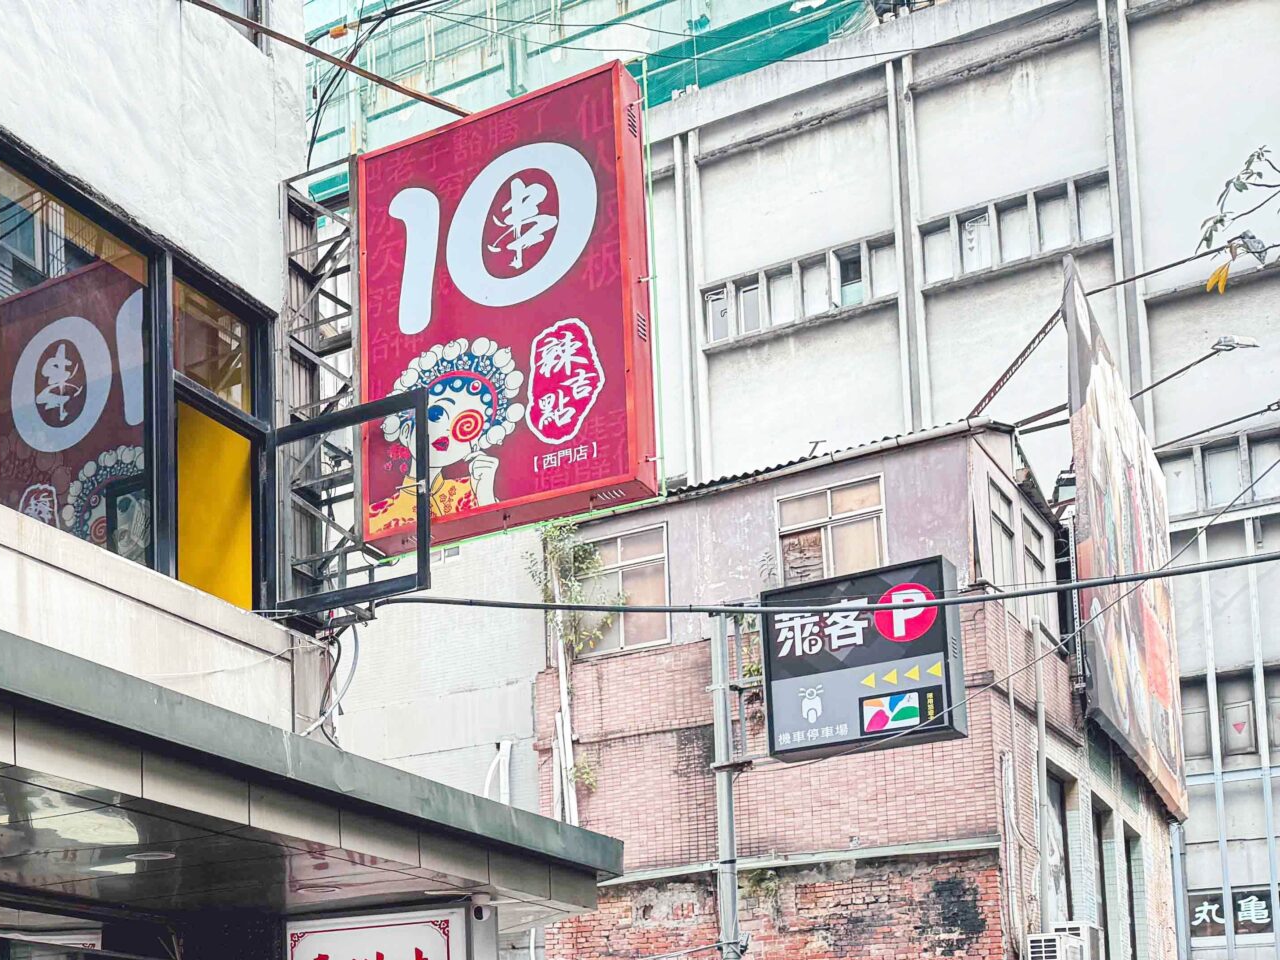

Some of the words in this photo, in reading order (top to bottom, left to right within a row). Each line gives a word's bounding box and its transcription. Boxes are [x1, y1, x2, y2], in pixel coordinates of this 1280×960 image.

[389, 141, 599, 335] 10
[487, 178, 559, 270] 串
[777, 723, 849, 744] 機車停車場
